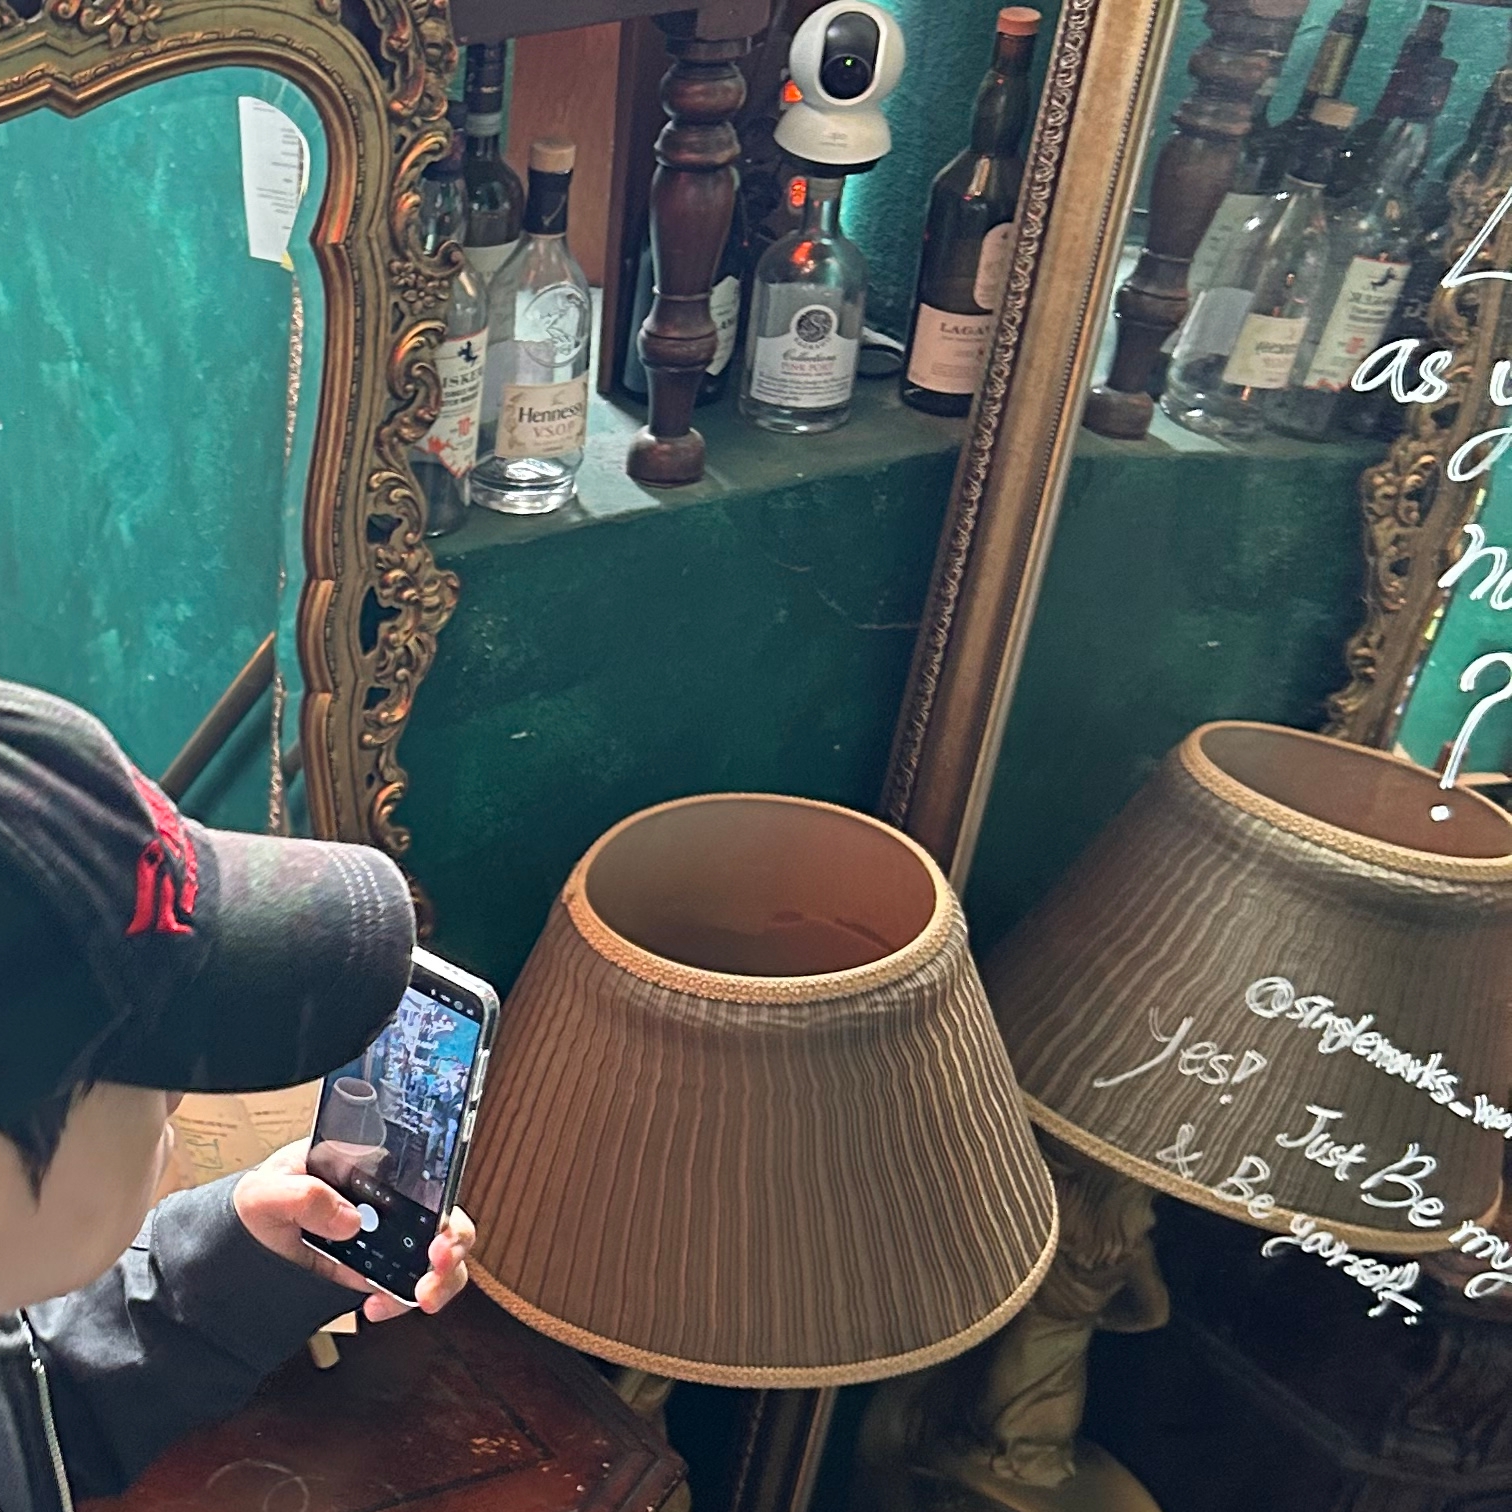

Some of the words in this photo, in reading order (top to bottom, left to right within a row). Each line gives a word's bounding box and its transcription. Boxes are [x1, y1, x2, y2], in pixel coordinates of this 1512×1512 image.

[1350, 337, 1453, 404] as
[1216, 1154, 1276, 1219] Be
[1275, 1105, 1367, 1181] Just
[1360, 1142, 1445, 1229] Be
